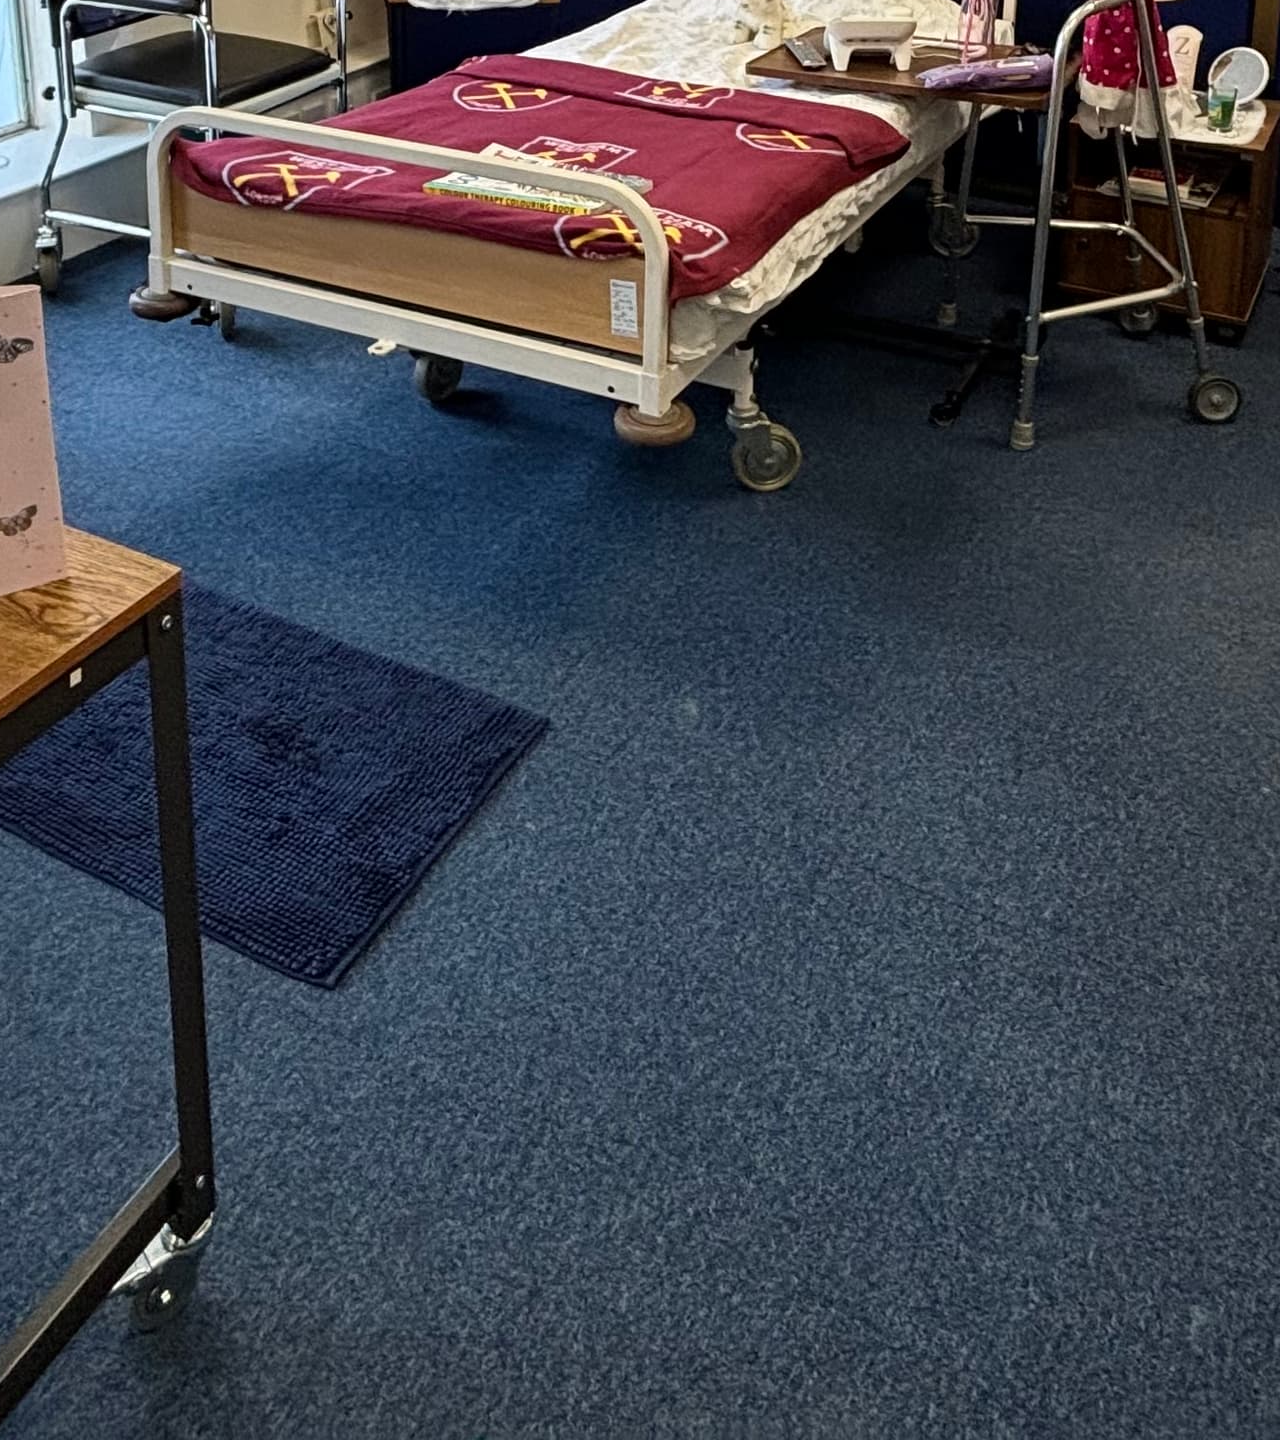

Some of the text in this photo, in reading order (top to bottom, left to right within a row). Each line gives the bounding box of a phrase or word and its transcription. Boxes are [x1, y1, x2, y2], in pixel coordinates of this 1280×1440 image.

[1175, 36, 1190, 55] Z
[470, 191, 504, 204] THERAPY
[505, 198, 550, 211] COLOURING
[552, 204, 576, 214] BOOK
